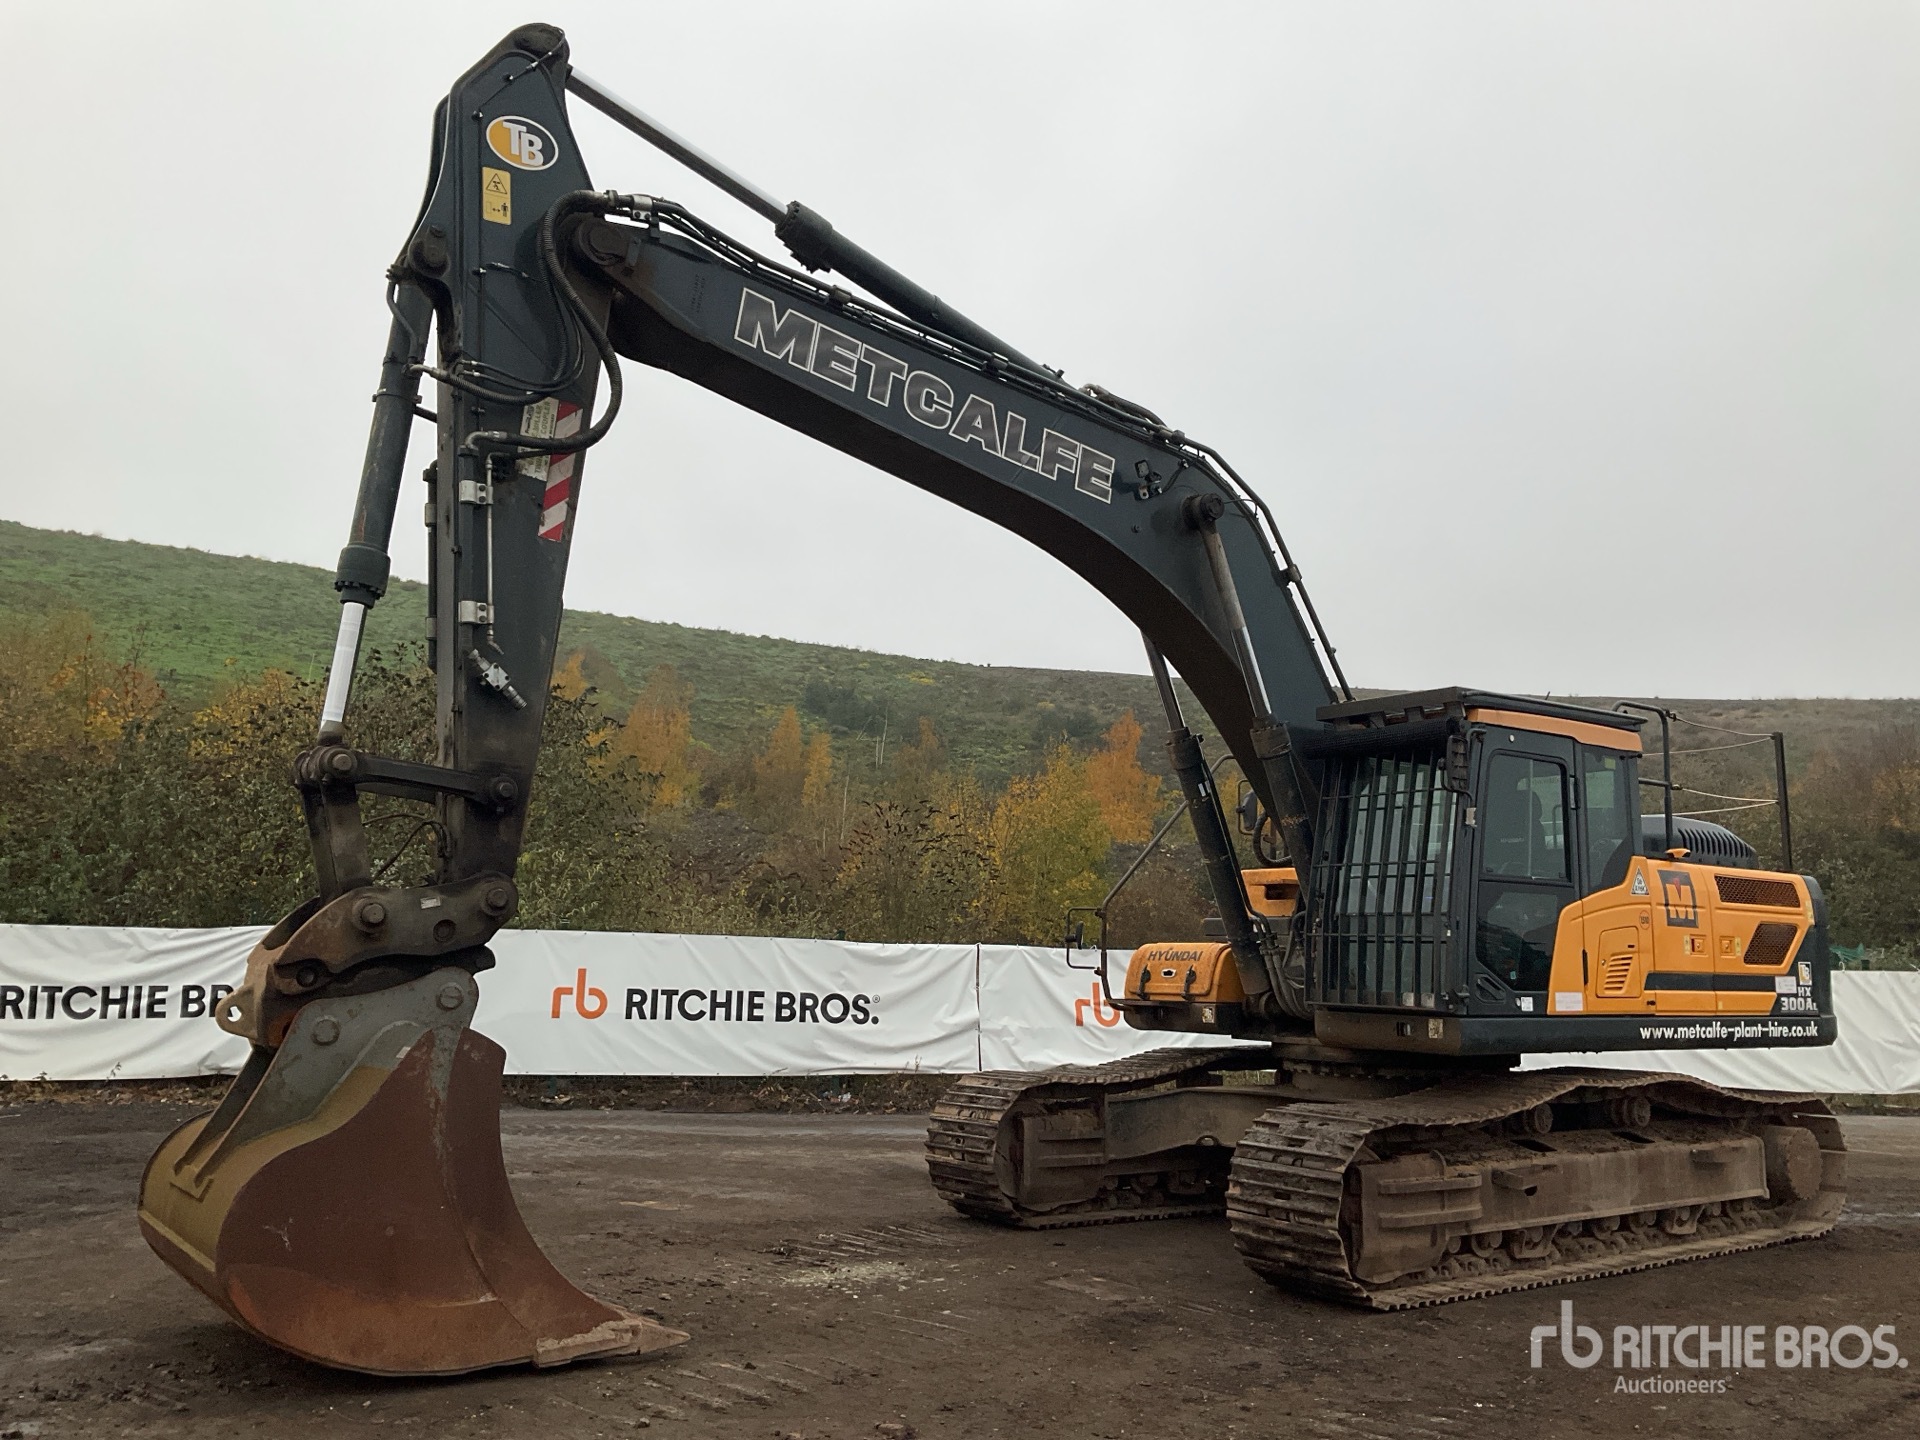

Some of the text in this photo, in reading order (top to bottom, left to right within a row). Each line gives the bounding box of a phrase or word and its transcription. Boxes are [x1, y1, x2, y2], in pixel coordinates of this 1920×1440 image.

[502, 121, 545, 167] TB
[734, 287, 1116, 504] METCALFE
[1147, 949, 1203, 962] HYUNDAI
[0, 985, 169, 1020] RITCHIE
[551, 968, 608, 1019] rb
[625, 988, 765, 1022] RITCHIE
[1797, 986, 1811, 997] HX
[1640, 1021, 1818, 1042] www.metcalfe-plant-hire.co.uk
